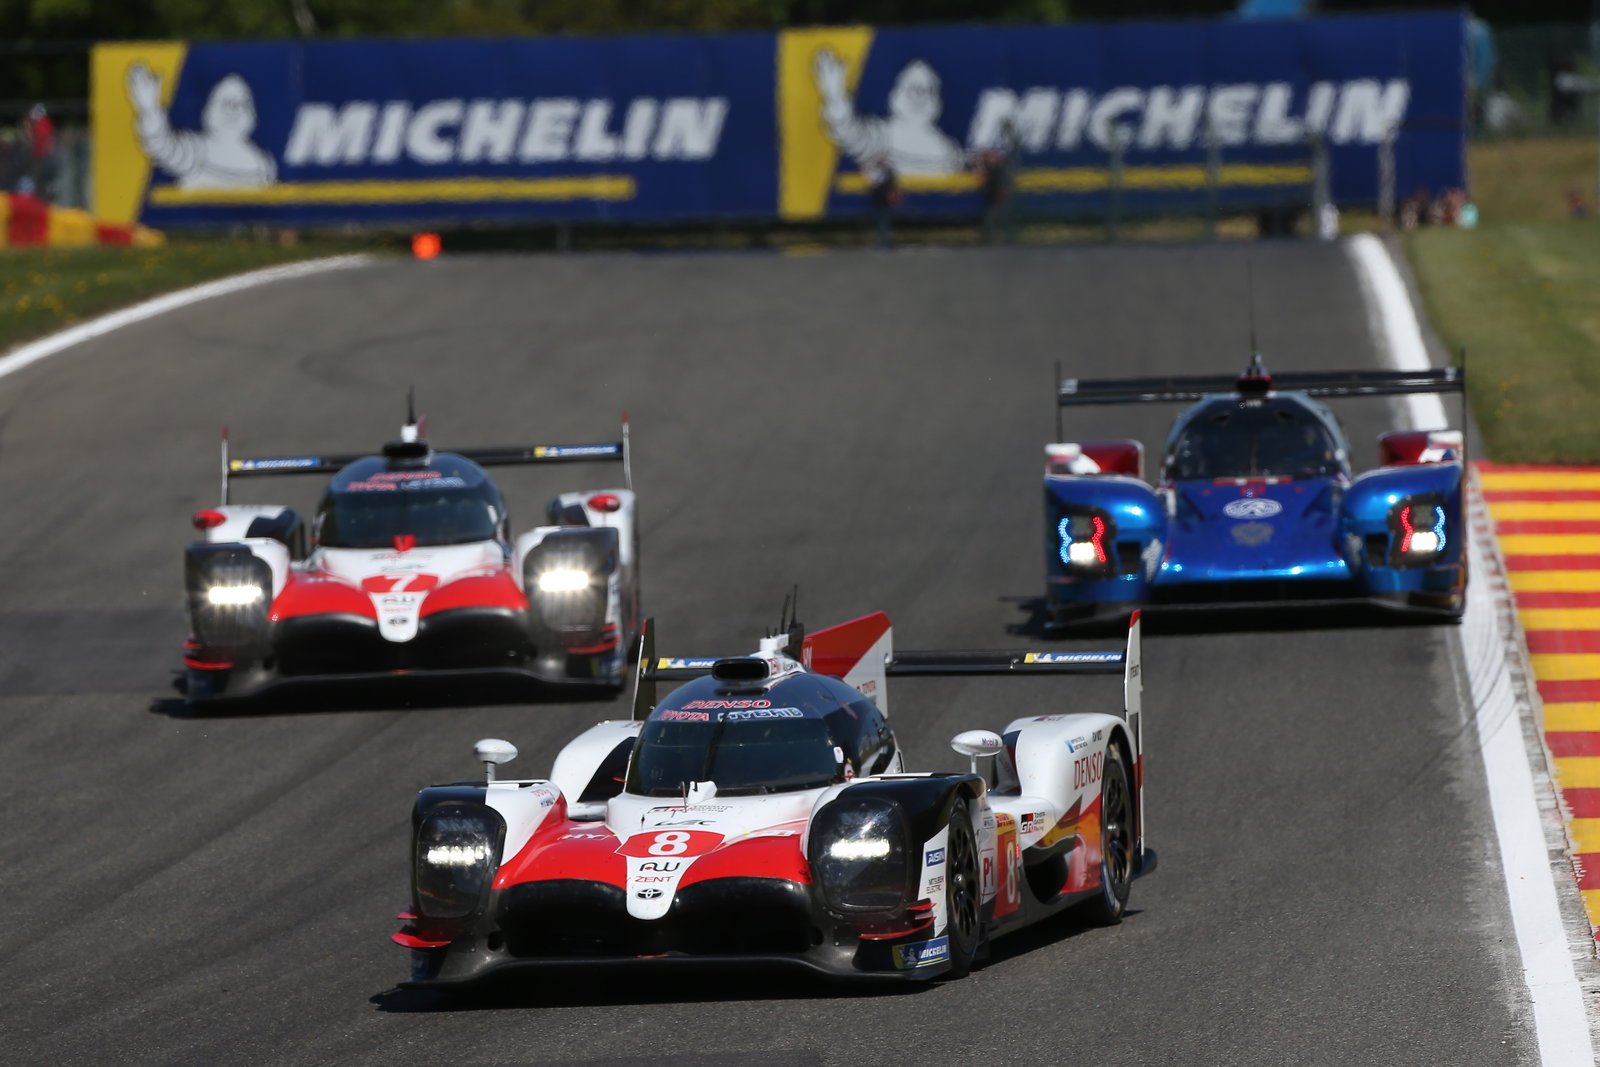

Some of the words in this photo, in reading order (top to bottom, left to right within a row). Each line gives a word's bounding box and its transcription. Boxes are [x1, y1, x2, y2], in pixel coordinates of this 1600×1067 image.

[968, 78, 1410, 154] MICHELIN
[284, 97, 729, 165] MICHELIN
[384, 573, 419, 593] 7
[1054, 653, 1122, 662] MICHELIN
[660, 709, 709, 721] TOYOTA
[681, 699, 771, 710] DENSO
[1073, 751, 1103, 790] DENSO
[648, 831, 691, 856] 8
[635, 875, 675, 883] ZENT
[984, 856, 994, 888] P1
[1007, 841, 1015, 904] 8
